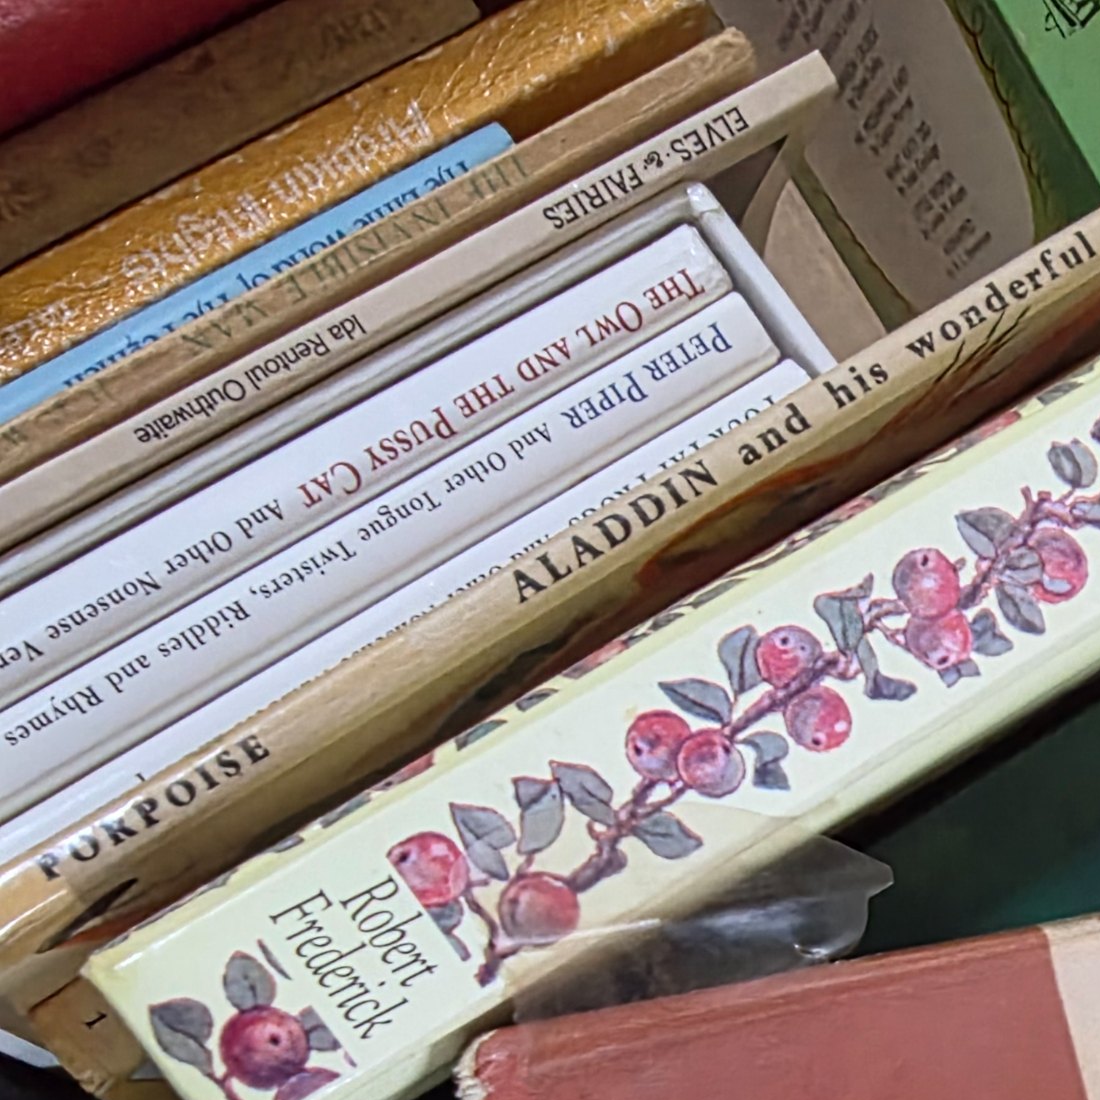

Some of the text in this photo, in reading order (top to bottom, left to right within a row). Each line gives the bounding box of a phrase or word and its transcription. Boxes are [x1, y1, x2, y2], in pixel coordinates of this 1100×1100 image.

[669, 106, 751, 164] ELVES
[542, 162, 646, 231] FAIRIES
[642, 268, 707, 322] THE
[326, 314, 369, 342] Ida
[575, 301, 644, 362] OWL
[642, 322, 734, 383] PETER
[243, 332, 332, 392] Rentoul
[516, 336, 572, 384] AND
[132, 378, 248, 447] Outhwaite
[452, 374, 517, 420] THE
[512, 459, 720, 606] ALADDIN
[737, 402, 814, 468] and
[822, 362, 890, 411] his
[903, 238, 1097, 358] wonderful
[560, 370, 650, 430] PIPER
[363, 406, 460, 473] PUSSY
[507, 422, 553, 462] And
[297, 461, 364, 517] CAT
[444, 451, 508, 494] Other
[234, 498, 285, 541] And
[357, 490, 443, 542] Tongue
[164, 530, 234, 576] Other
[248, 540, 358, 600] Twisters,
[46, 570, 163, 641] Nonsense
[157, 600, 252, 659] Riddles
[104, 654, 152, 695] and
[4, 685, 106, 748] Rhymes
[36, 733, 270, 881] PORPOISE
[338, 874, 439, 988] Robert
[268, 888, 410, 1041] Frederick
